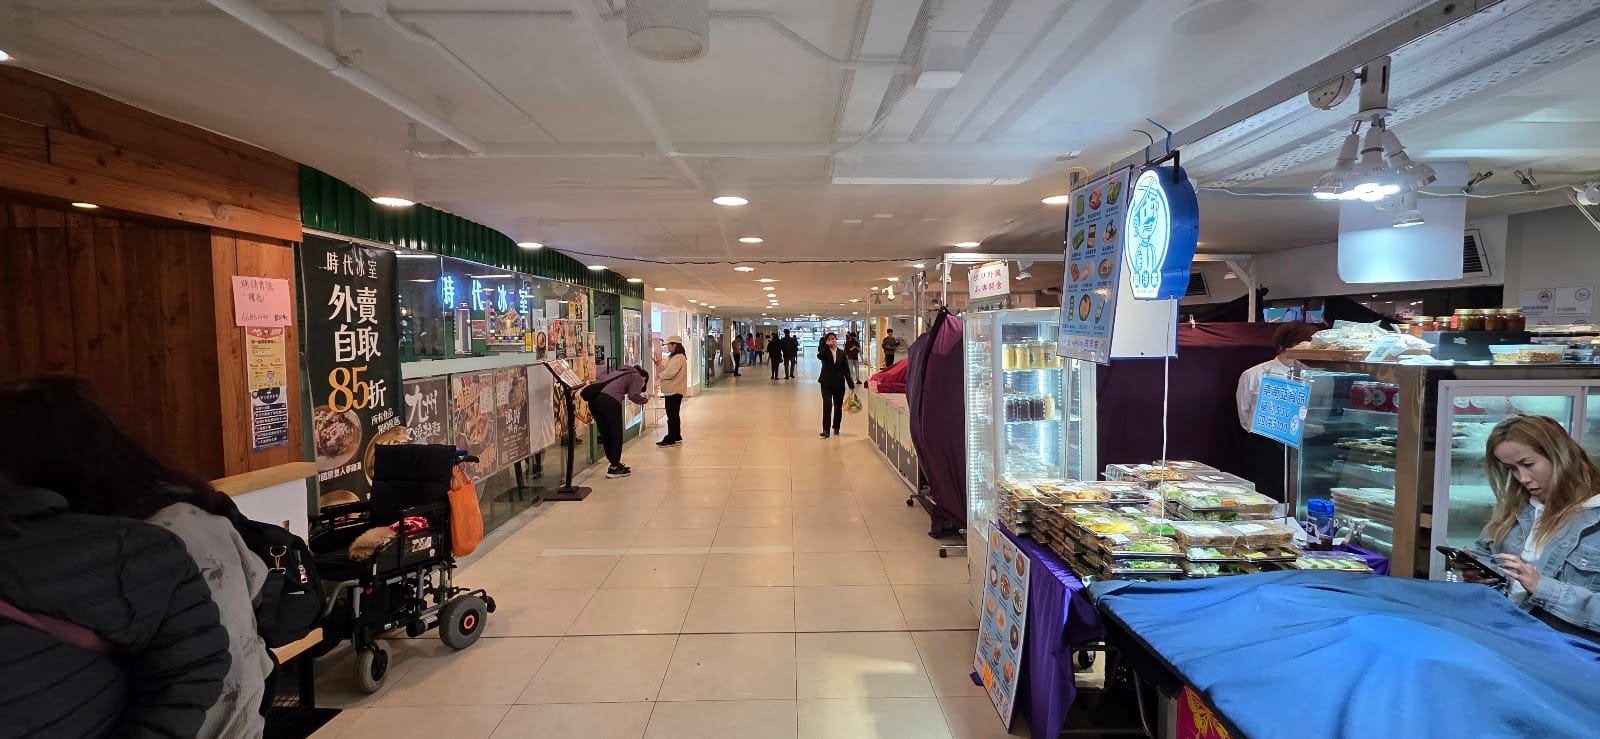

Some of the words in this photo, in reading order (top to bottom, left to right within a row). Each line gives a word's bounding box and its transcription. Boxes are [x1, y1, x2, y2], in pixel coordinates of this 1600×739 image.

[326, 251, 378, 279] 時代冰室
[327, 283, 378, 325] 外賣
[442, 275, 529, 314] 時代冰室
[334, 323, 382, 362] 自取
[328, 365, 387, 413] 85折
[404, 384, 438, 428] 九州
